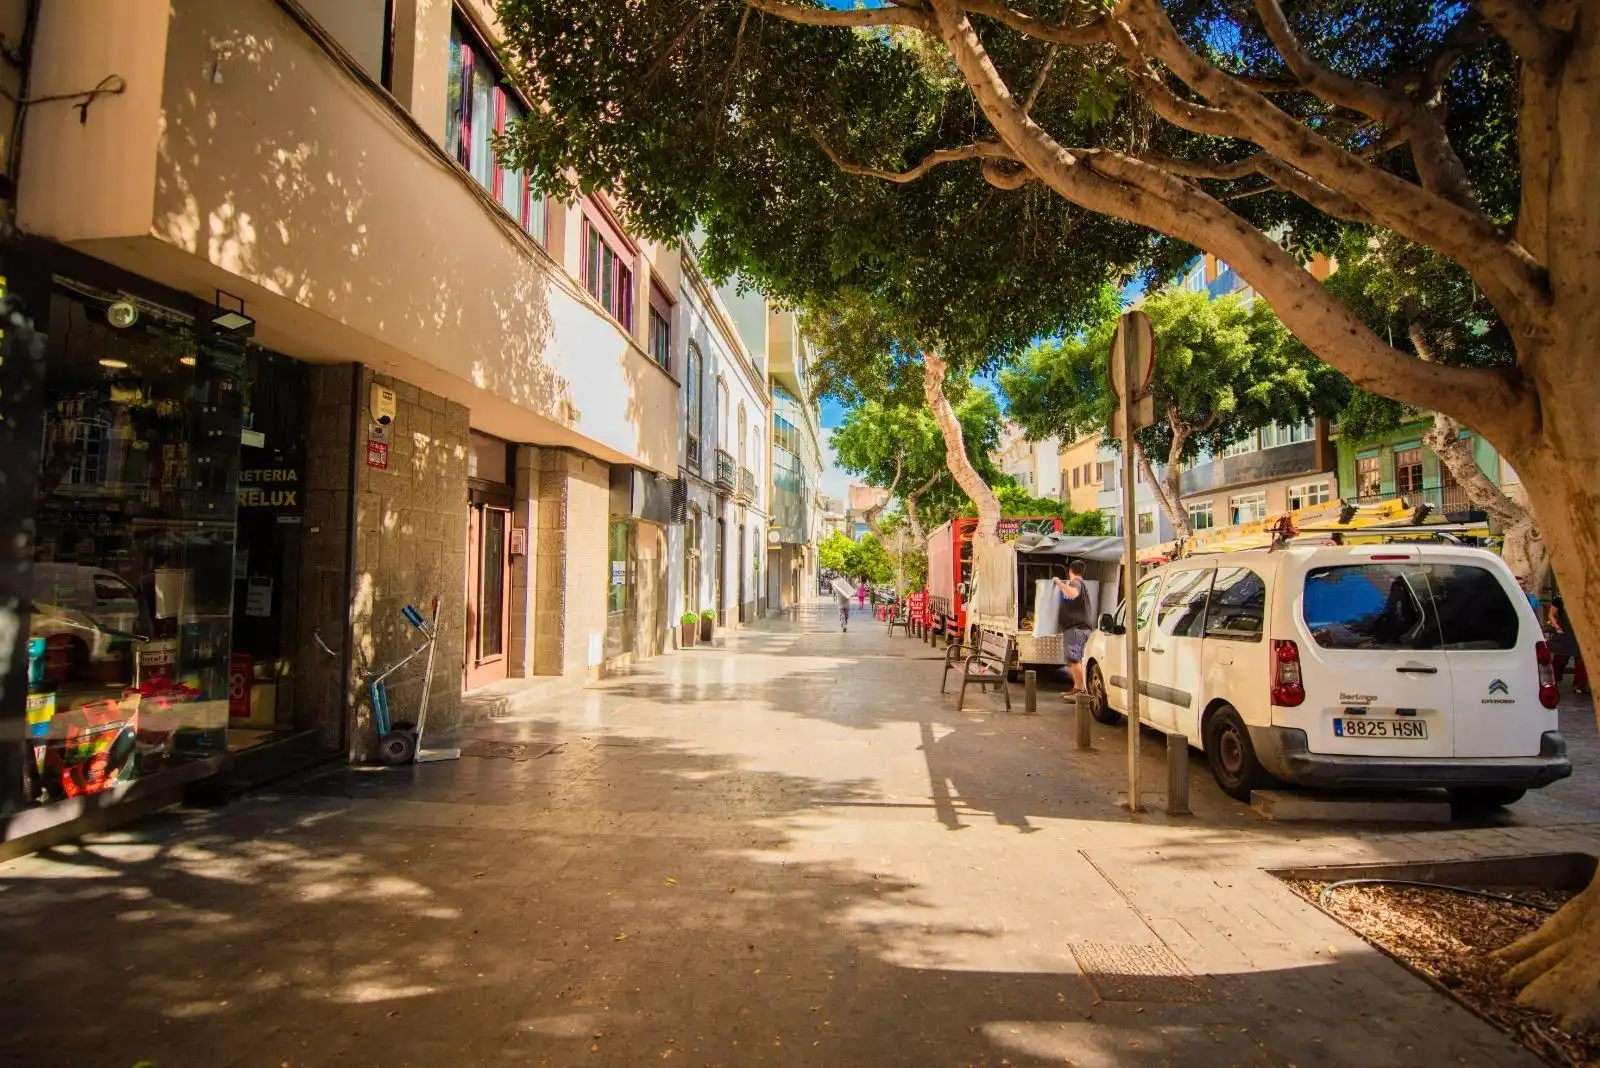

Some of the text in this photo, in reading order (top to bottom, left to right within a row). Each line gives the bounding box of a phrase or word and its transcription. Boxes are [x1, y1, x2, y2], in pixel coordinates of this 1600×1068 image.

[1339, 692, 1378, 702] Berlingo
[1346, 721, 1424, 737] 8825 HSN
